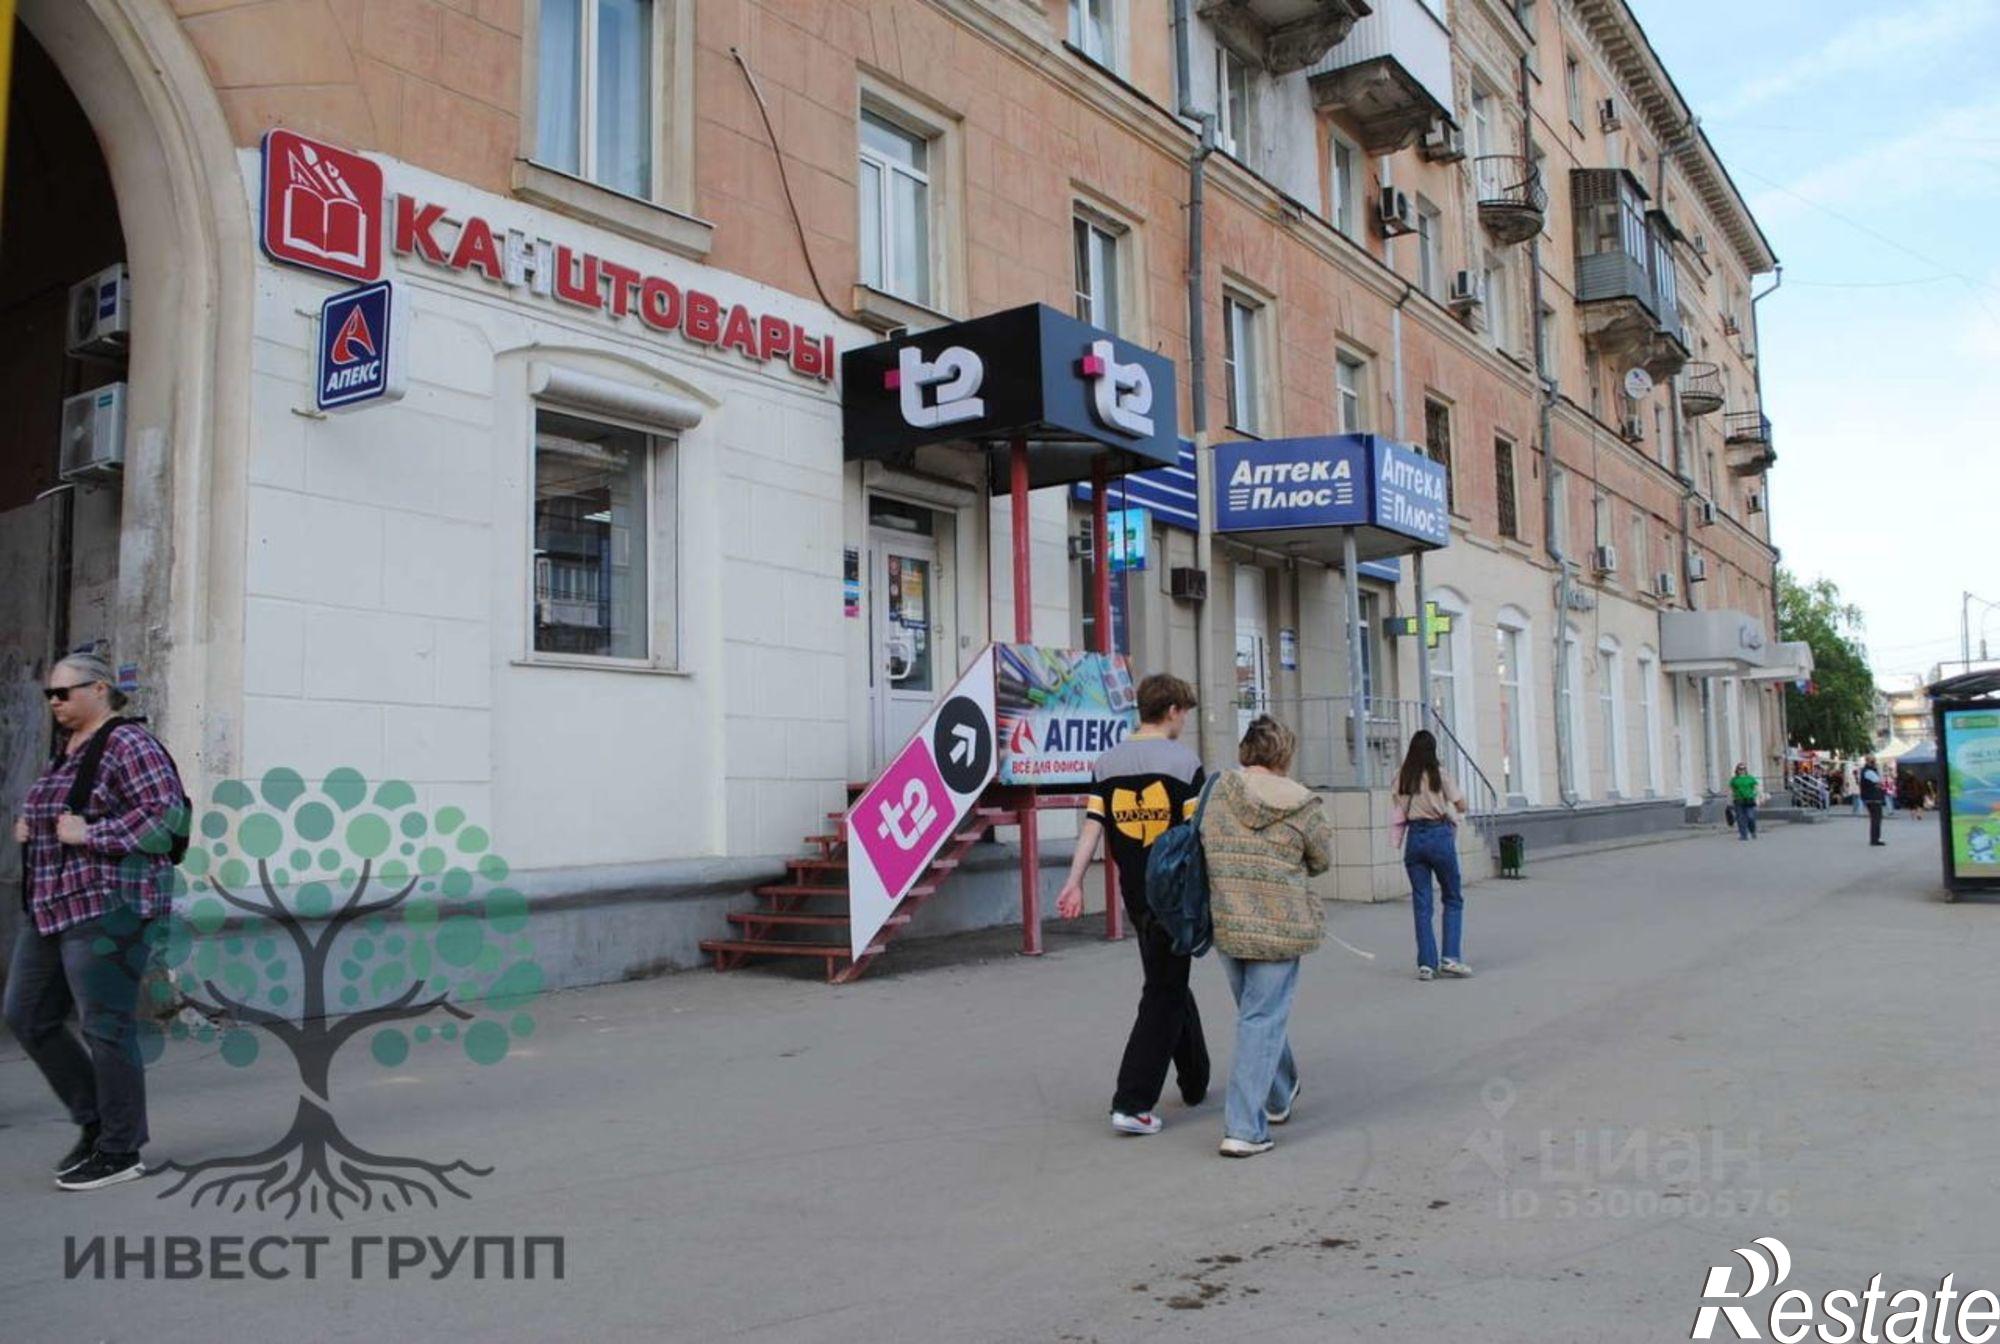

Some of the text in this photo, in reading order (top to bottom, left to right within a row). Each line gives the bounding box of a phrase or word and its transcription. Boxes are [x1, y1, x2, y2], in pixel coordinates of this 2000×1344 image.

[392, 193, 835, 382] КАНЦТОВАРЫ
[326, 360, 380, 393] АПЕКС
[884, 345, 985, 430] t2
[1083, 339, 1155, 438] t2
[1251, 486, 1332, 510] Плюс
[877, 777, 938, 850] t2
